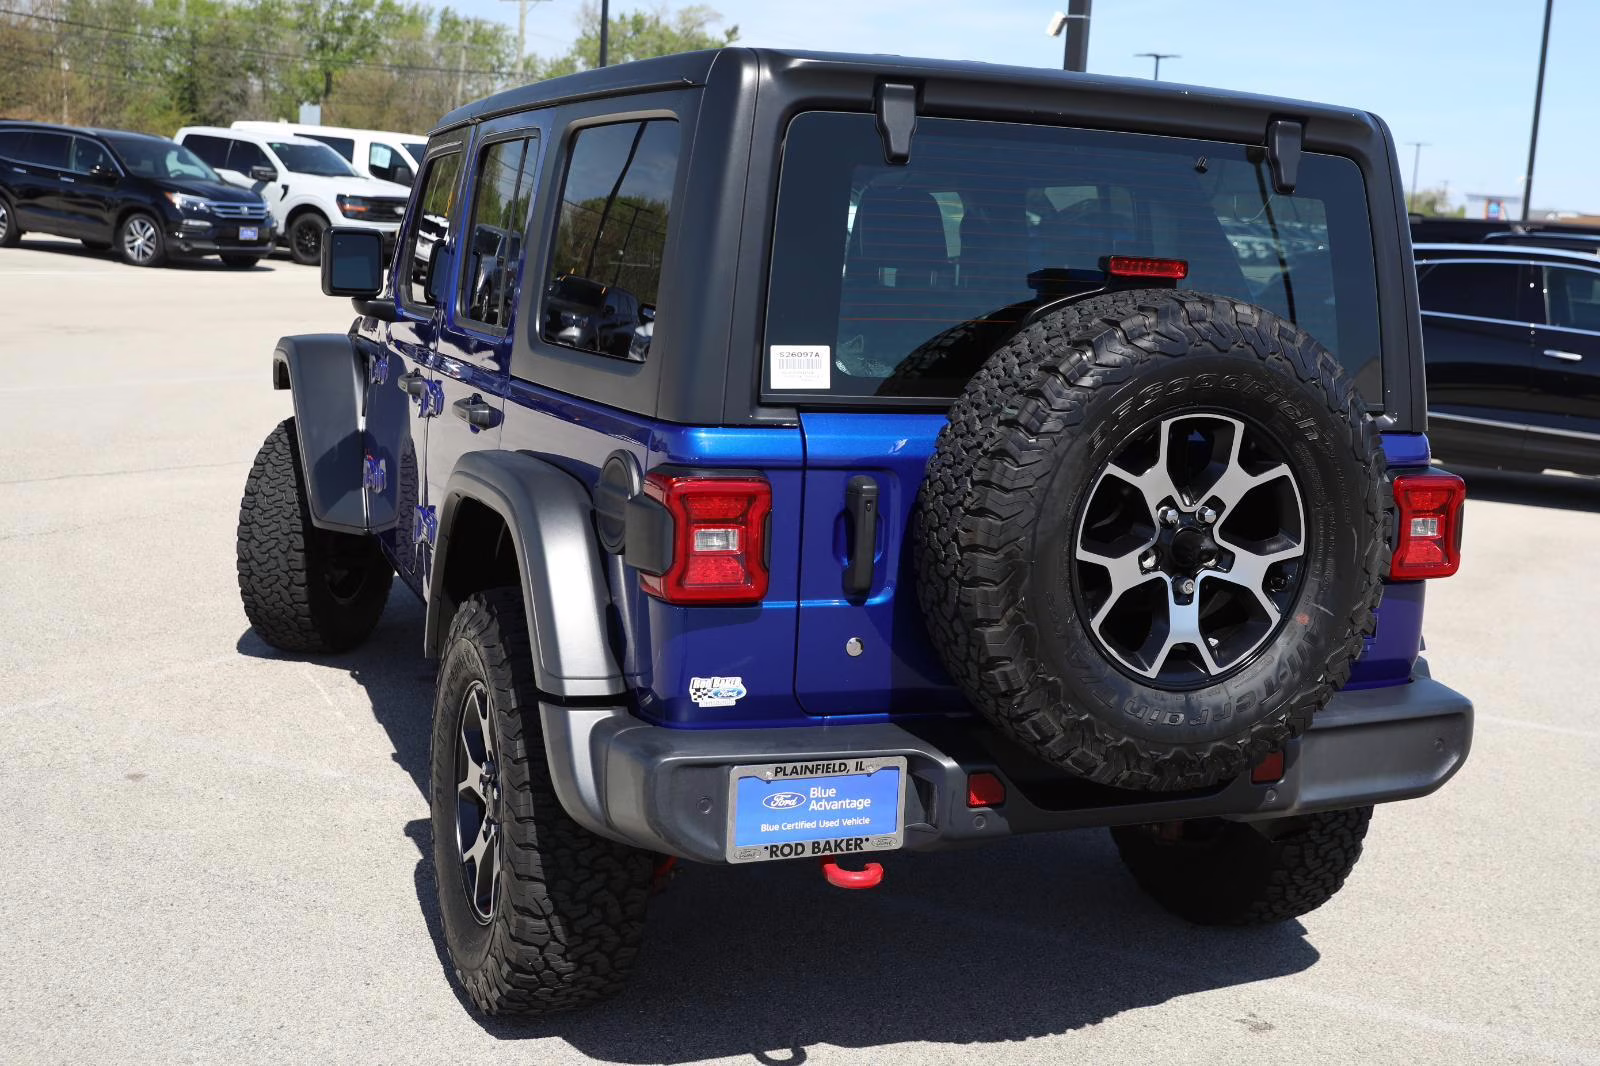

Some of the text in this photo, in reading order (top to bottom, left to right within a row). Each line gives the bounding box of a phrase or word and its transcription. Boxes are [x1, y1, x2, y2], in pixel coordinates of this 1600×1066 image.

[774, 762, 850, 777] PLAINFIELD,
[855, 761, 865, 772] IL
[769, 793, 799, 808] Ford
[809, 787, 837, 799] Blue
[808, 798, 871, 811] Advantage
[761, 816, 871, 832] Blue Certified Used Vehicle
[768, 837, 865, 859] ROD BAKER
